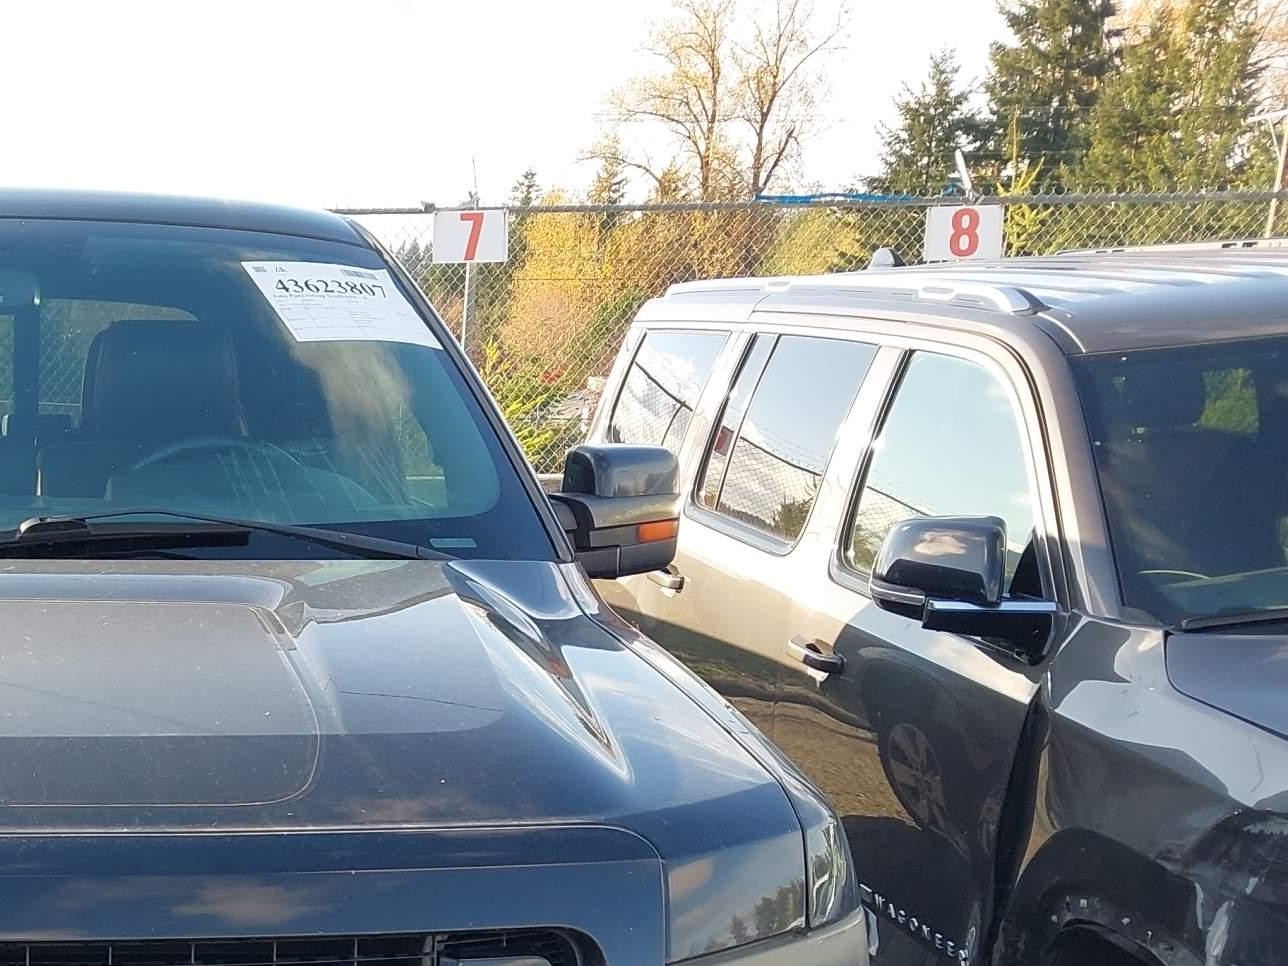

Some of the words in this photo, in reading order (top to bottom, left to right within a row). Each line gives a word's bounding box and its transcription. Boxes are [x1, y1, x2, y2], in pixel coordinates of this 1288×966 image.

[460, 212, 485, 260] 7
[948, 207, 981, 258] 8
[275, 278, 387, 298] 43623807
